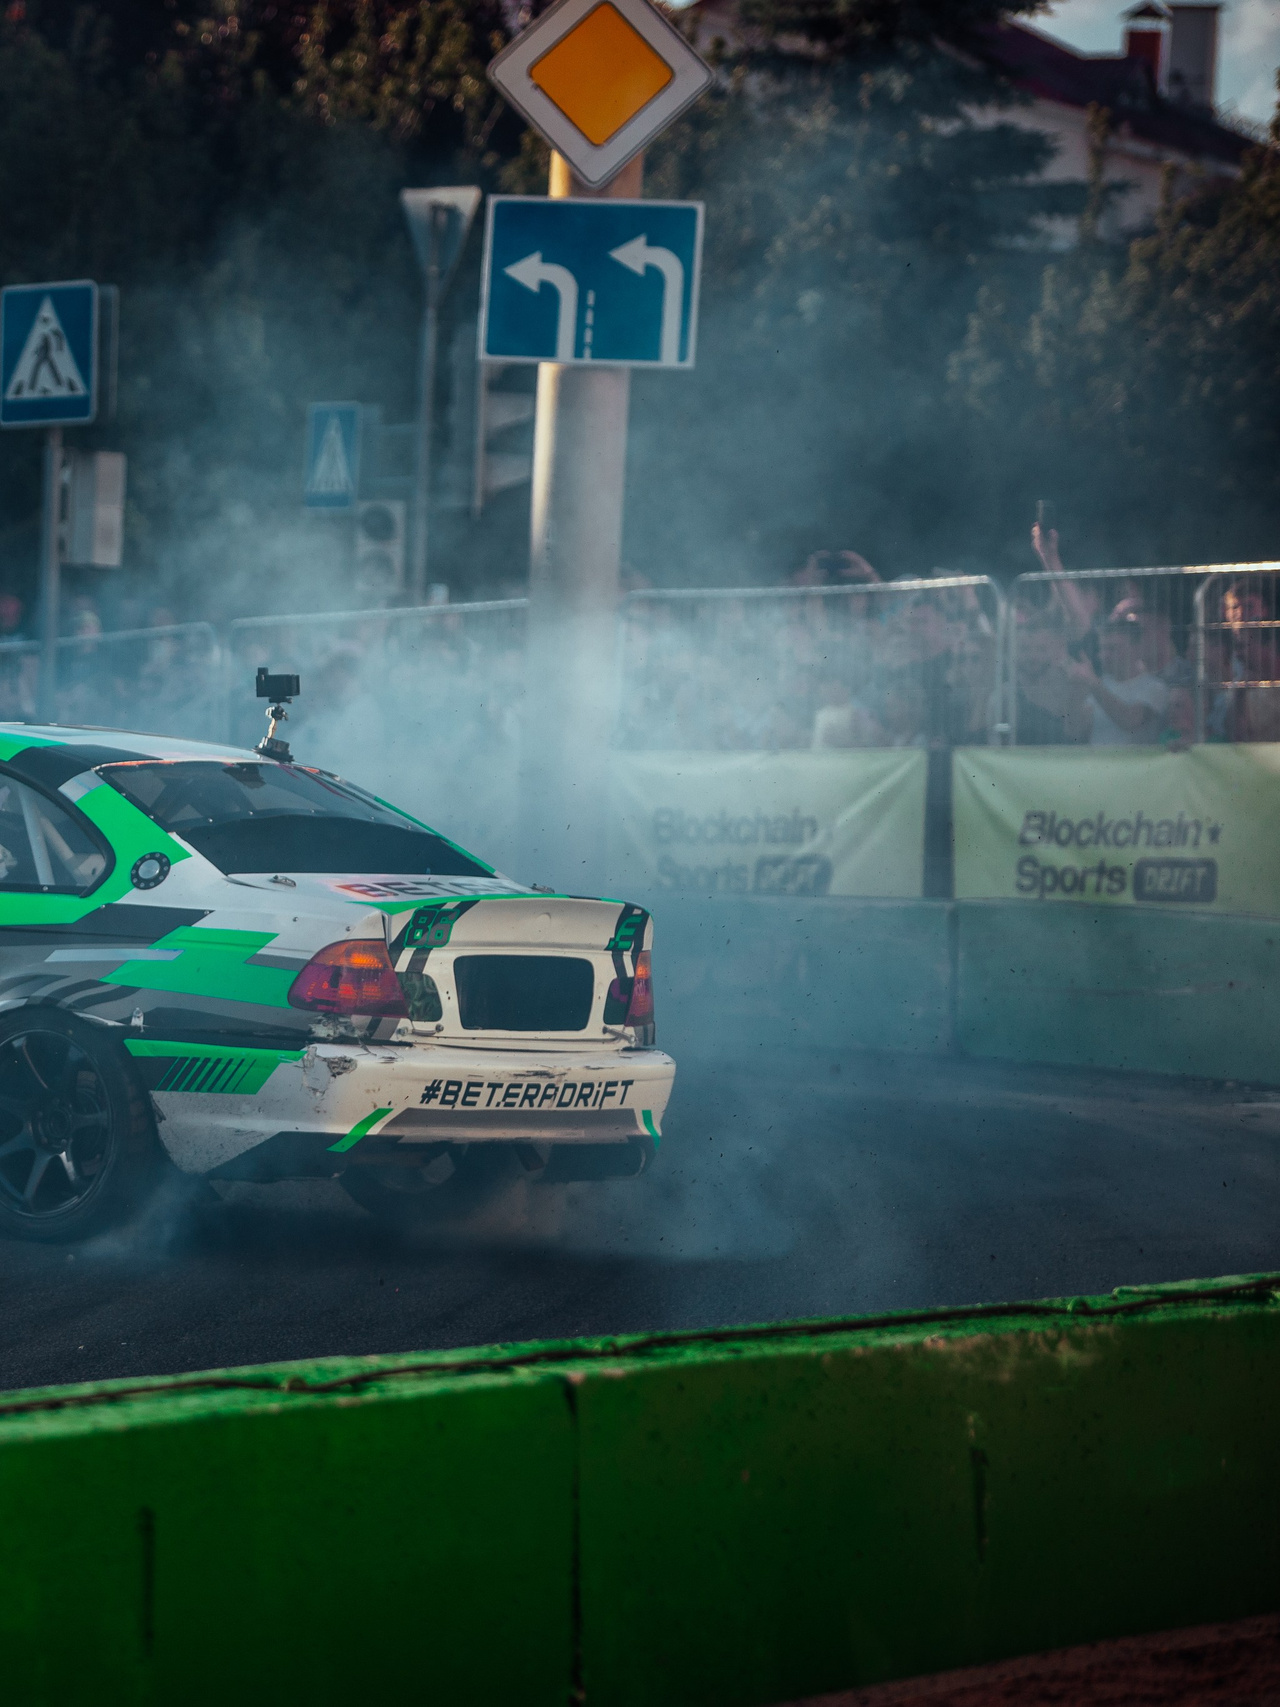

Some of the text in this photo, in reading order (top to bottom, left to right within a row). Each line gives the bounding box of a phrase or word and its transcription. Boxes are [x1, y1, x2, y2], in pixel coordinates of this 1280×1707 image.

[1019, 810, 1202, 847] Blockchain
[1016, 855, 1127, 900] Sports
[404, 909, 460, 948] 86
